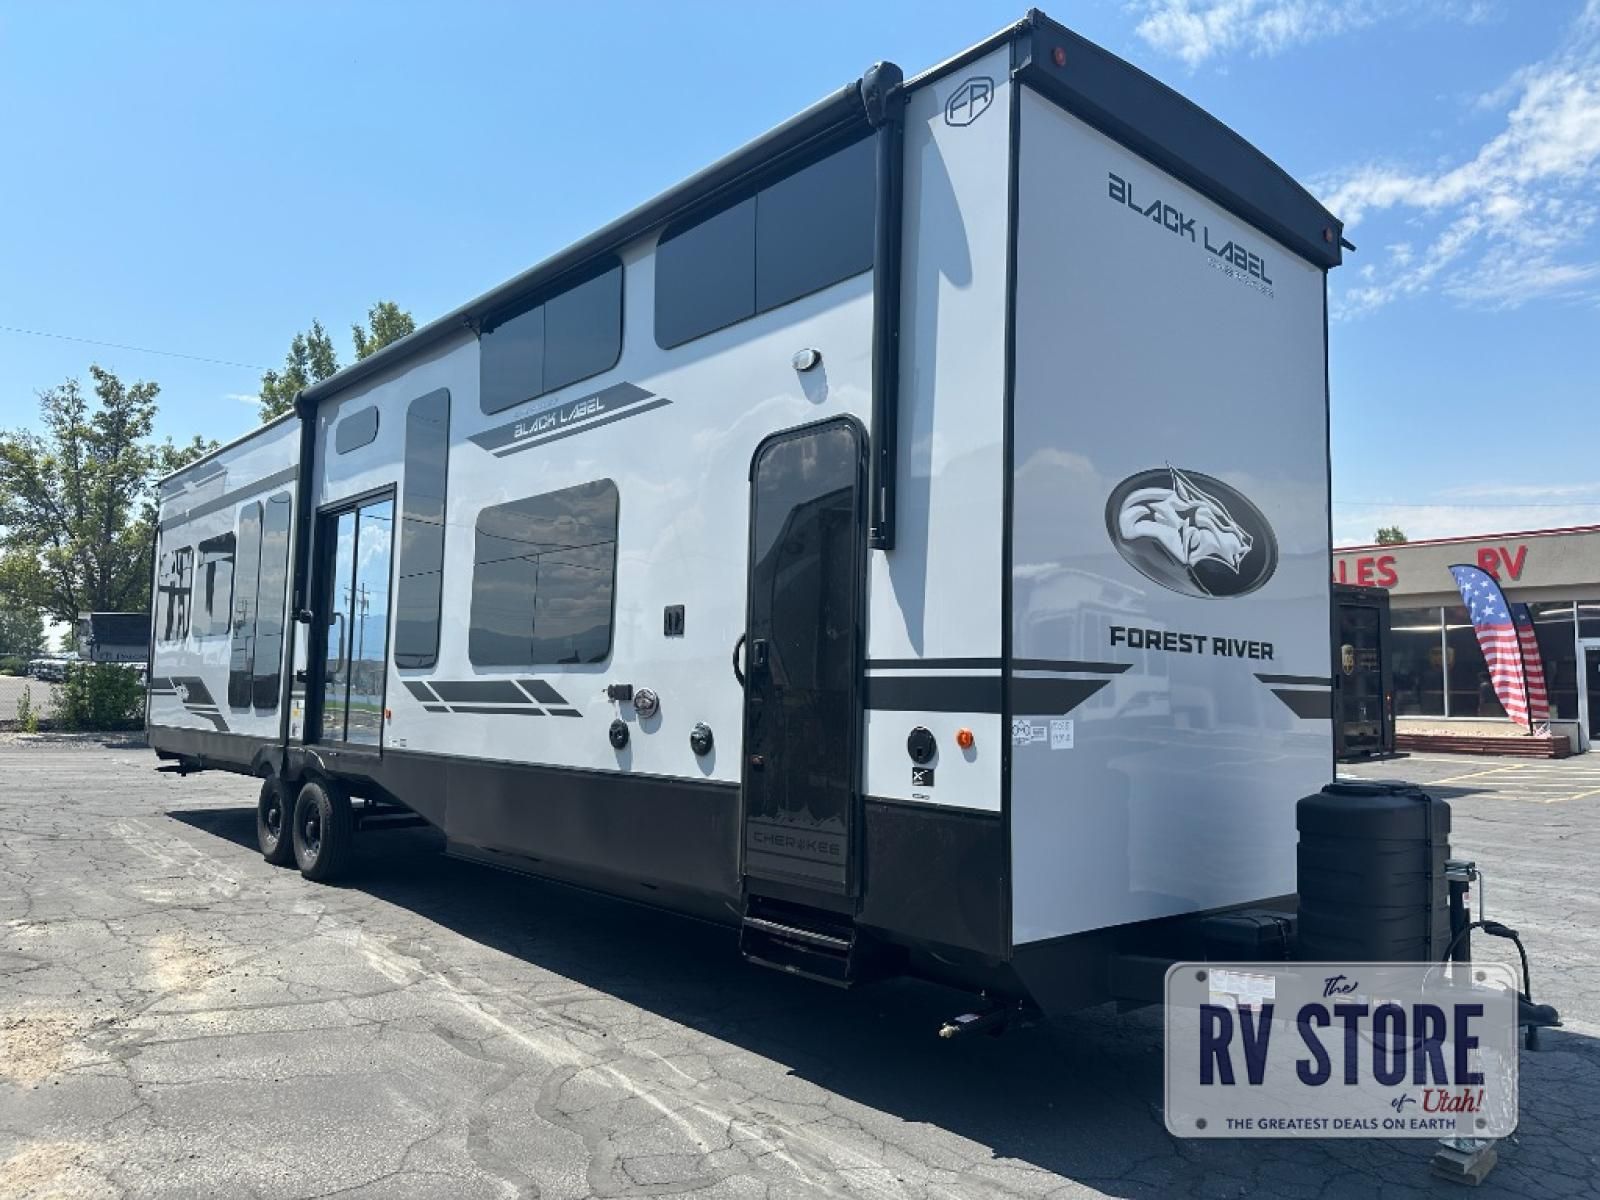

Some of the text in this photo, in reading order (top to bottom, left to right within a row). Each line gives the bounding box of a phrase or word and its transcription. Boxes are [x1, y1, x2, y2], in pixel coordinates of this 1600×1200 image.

[1108, 172, 1196, 243] BLACK
[1204, 226, 1273, 285] LABEL
[513, 411, 557, 438] BLACK
[560, 396, 606, 423] LABEL
[1477, 545, 1528, 581] RV
[1109, 626, 1274, 660] FOREST RIVER
